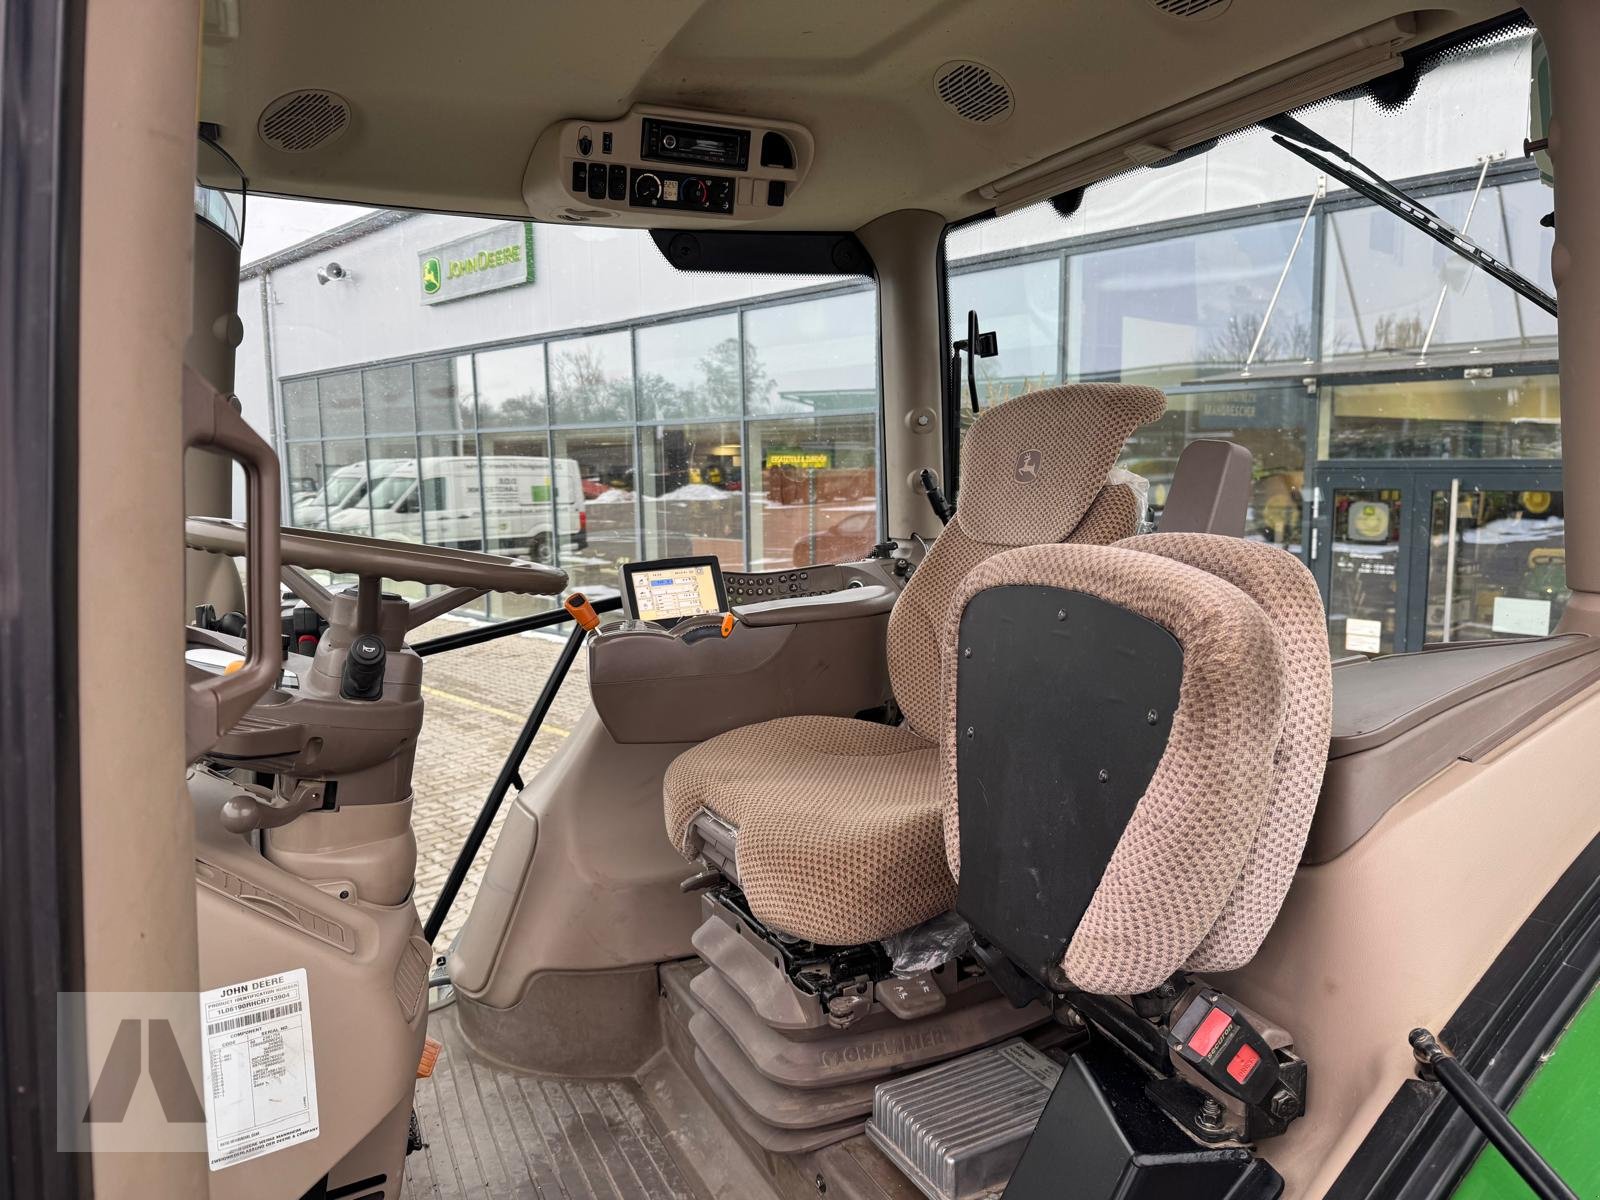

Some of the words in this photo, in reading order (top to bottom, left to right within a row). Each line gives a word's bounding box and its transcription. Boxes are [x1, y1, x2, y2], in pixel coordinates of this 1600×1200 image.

[446, 257, 478, 281] JOHN
[478, 244, 521, 272] DEERE
[220, 984, 249, 998] JOHN
[252, 976, 285, 991] DEERE
[208, 999, 233, 1009] PRODUCT
[234, 989, 275, 1003] IDENTIFICATION
[230, 1026, 263, 1039] COMPONENT
